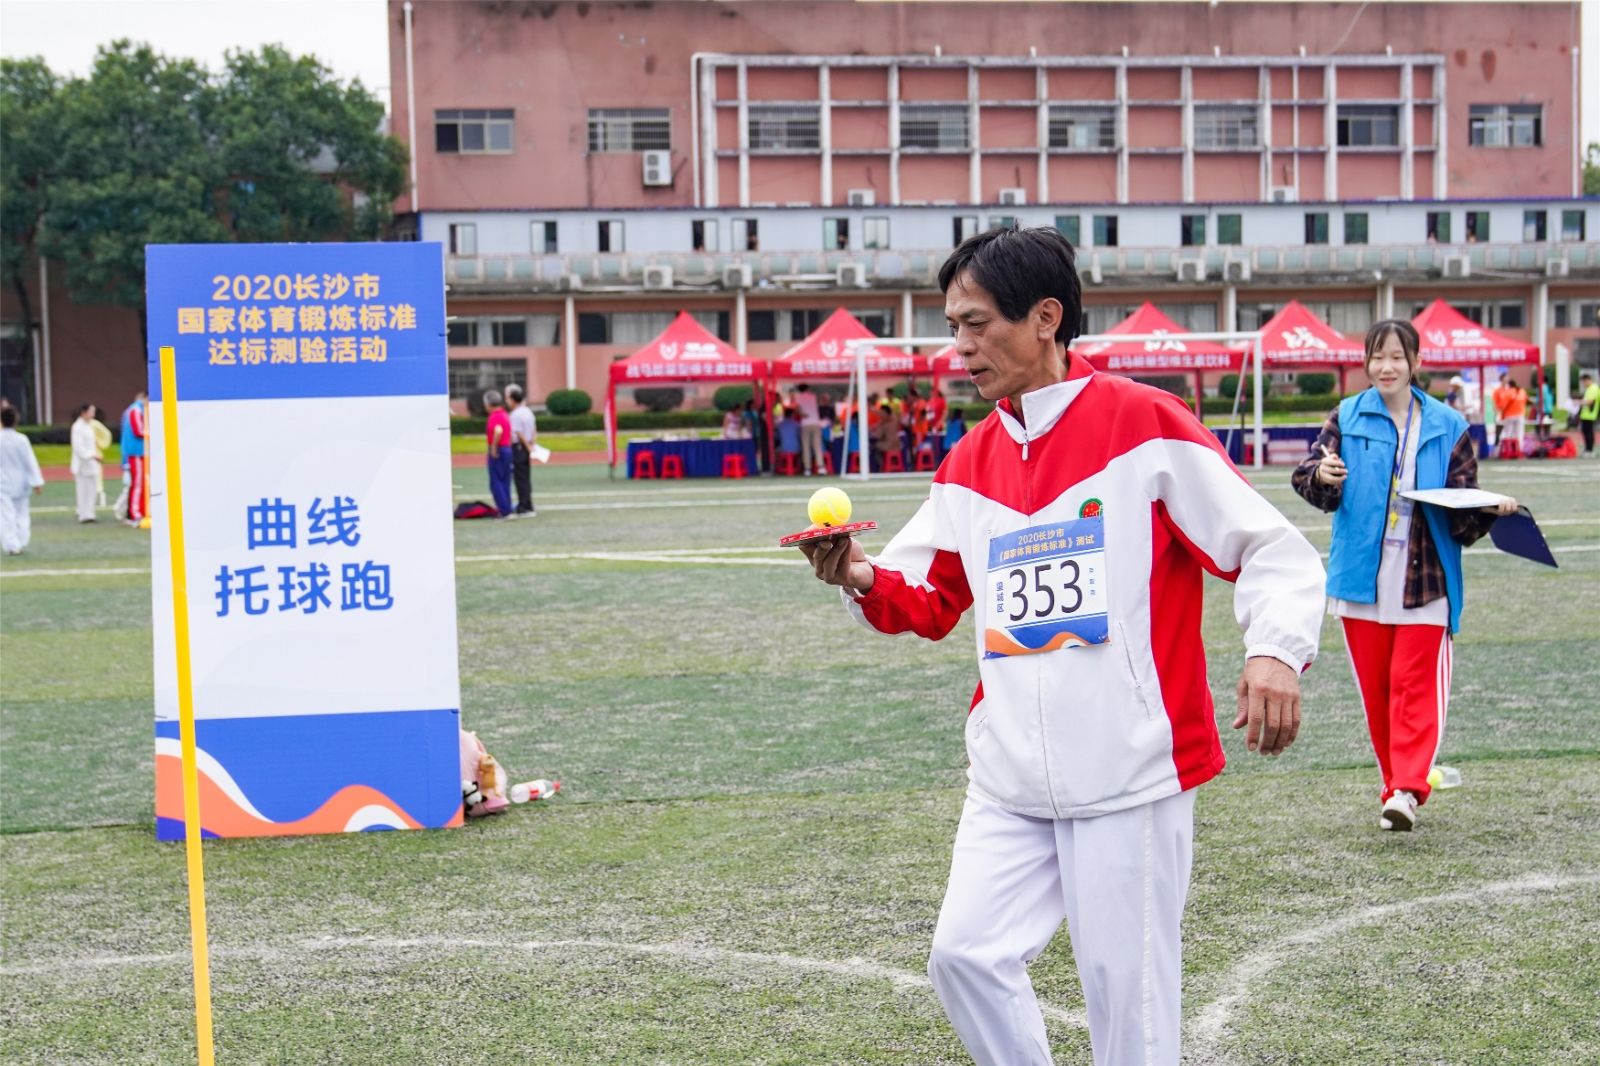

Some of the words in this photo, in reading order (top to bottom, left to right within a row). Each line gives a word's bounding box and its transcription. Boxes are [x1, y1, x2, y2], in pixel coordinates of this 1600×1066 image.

[212, 273, 380, 301] 2020长沙市
[177, 304, 417, 334] 国家体育锻炼标准
[208, 336, 388, 365] 达标测验活动
[246, 496, 361, 550] 曲线
[1018, 528, 1064, 545] 2020长沙市
[214, 560, 394, 617] 托球跑
[1009, 559, 1083, 621] 353
